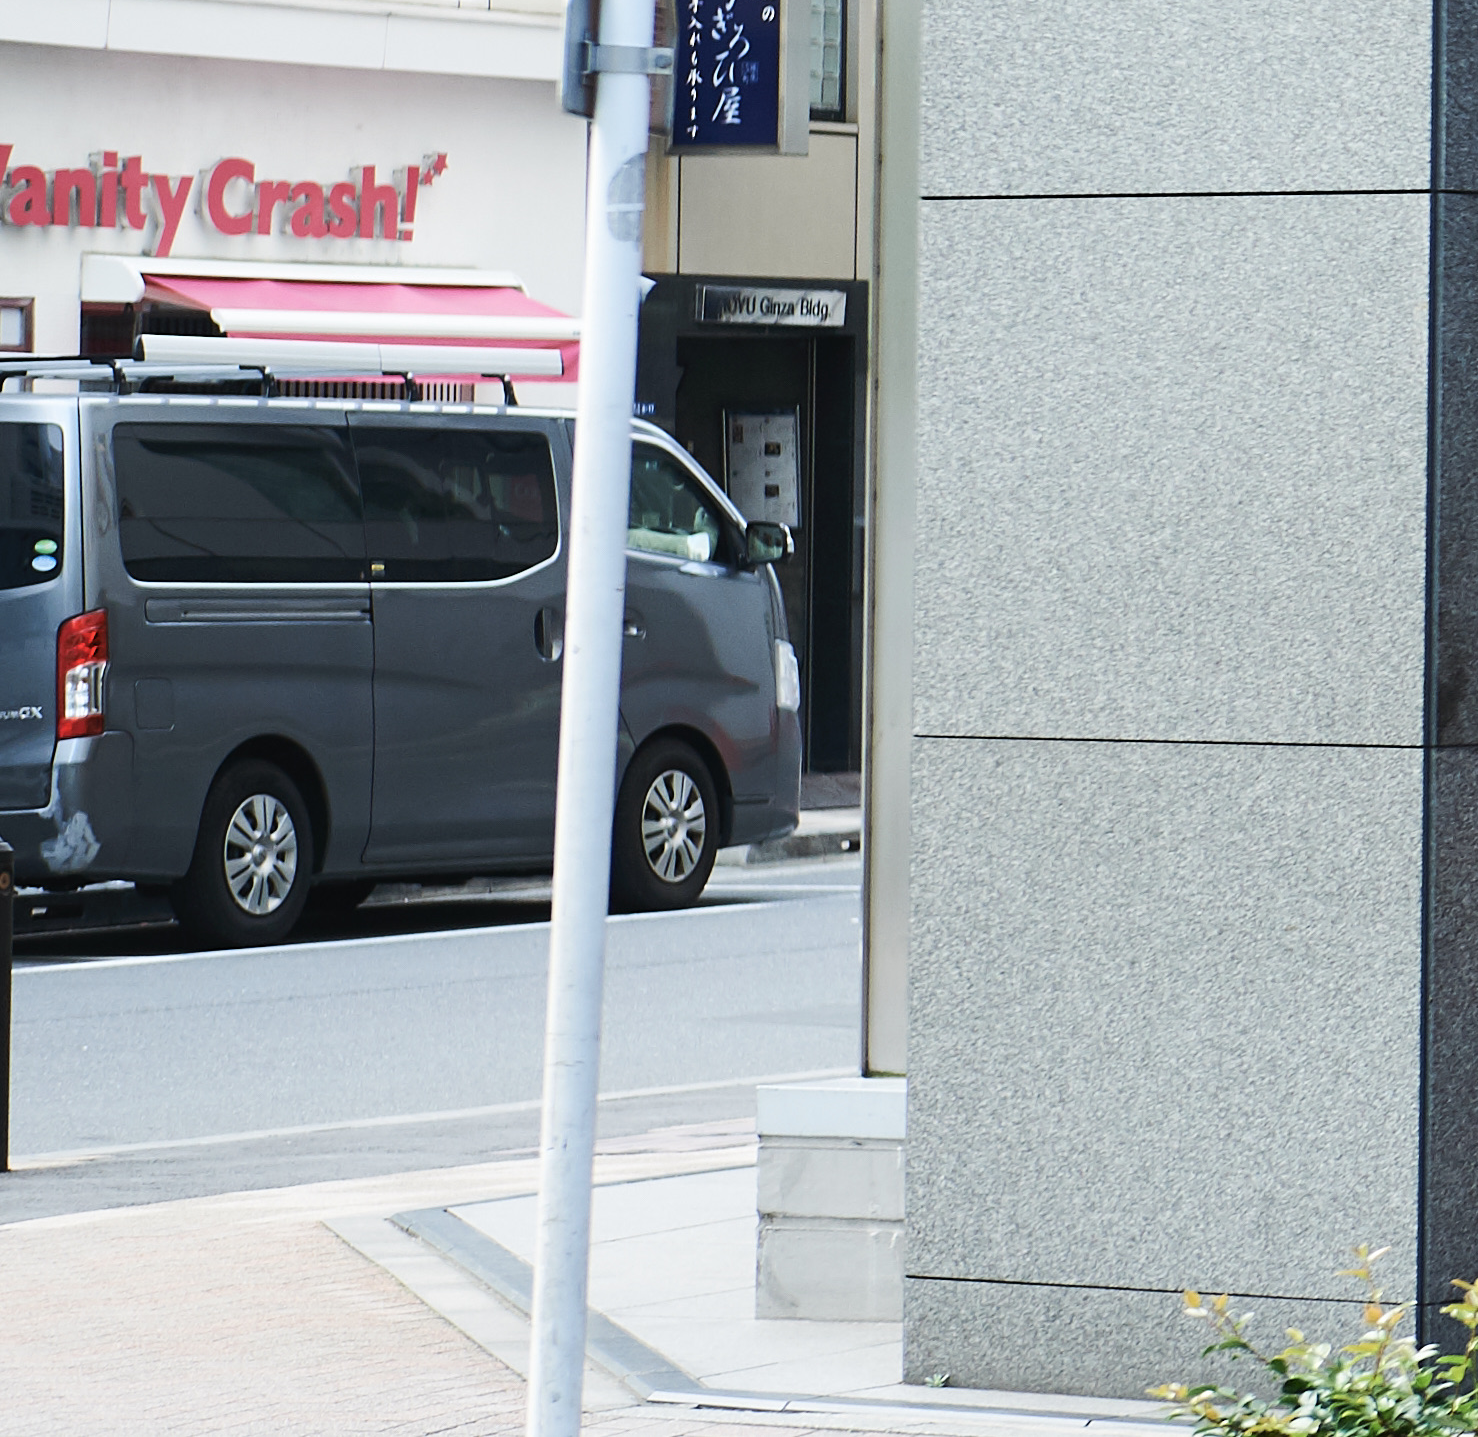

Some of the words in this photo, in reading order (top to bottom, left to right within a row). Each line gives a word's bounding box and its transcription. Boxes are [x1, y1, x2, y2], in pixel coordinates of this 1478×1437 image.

[207, 156, 421, 243] Crash!
[760, 295, 795, 317] Ginza
[801, 297, 832, 322] Bldg.
